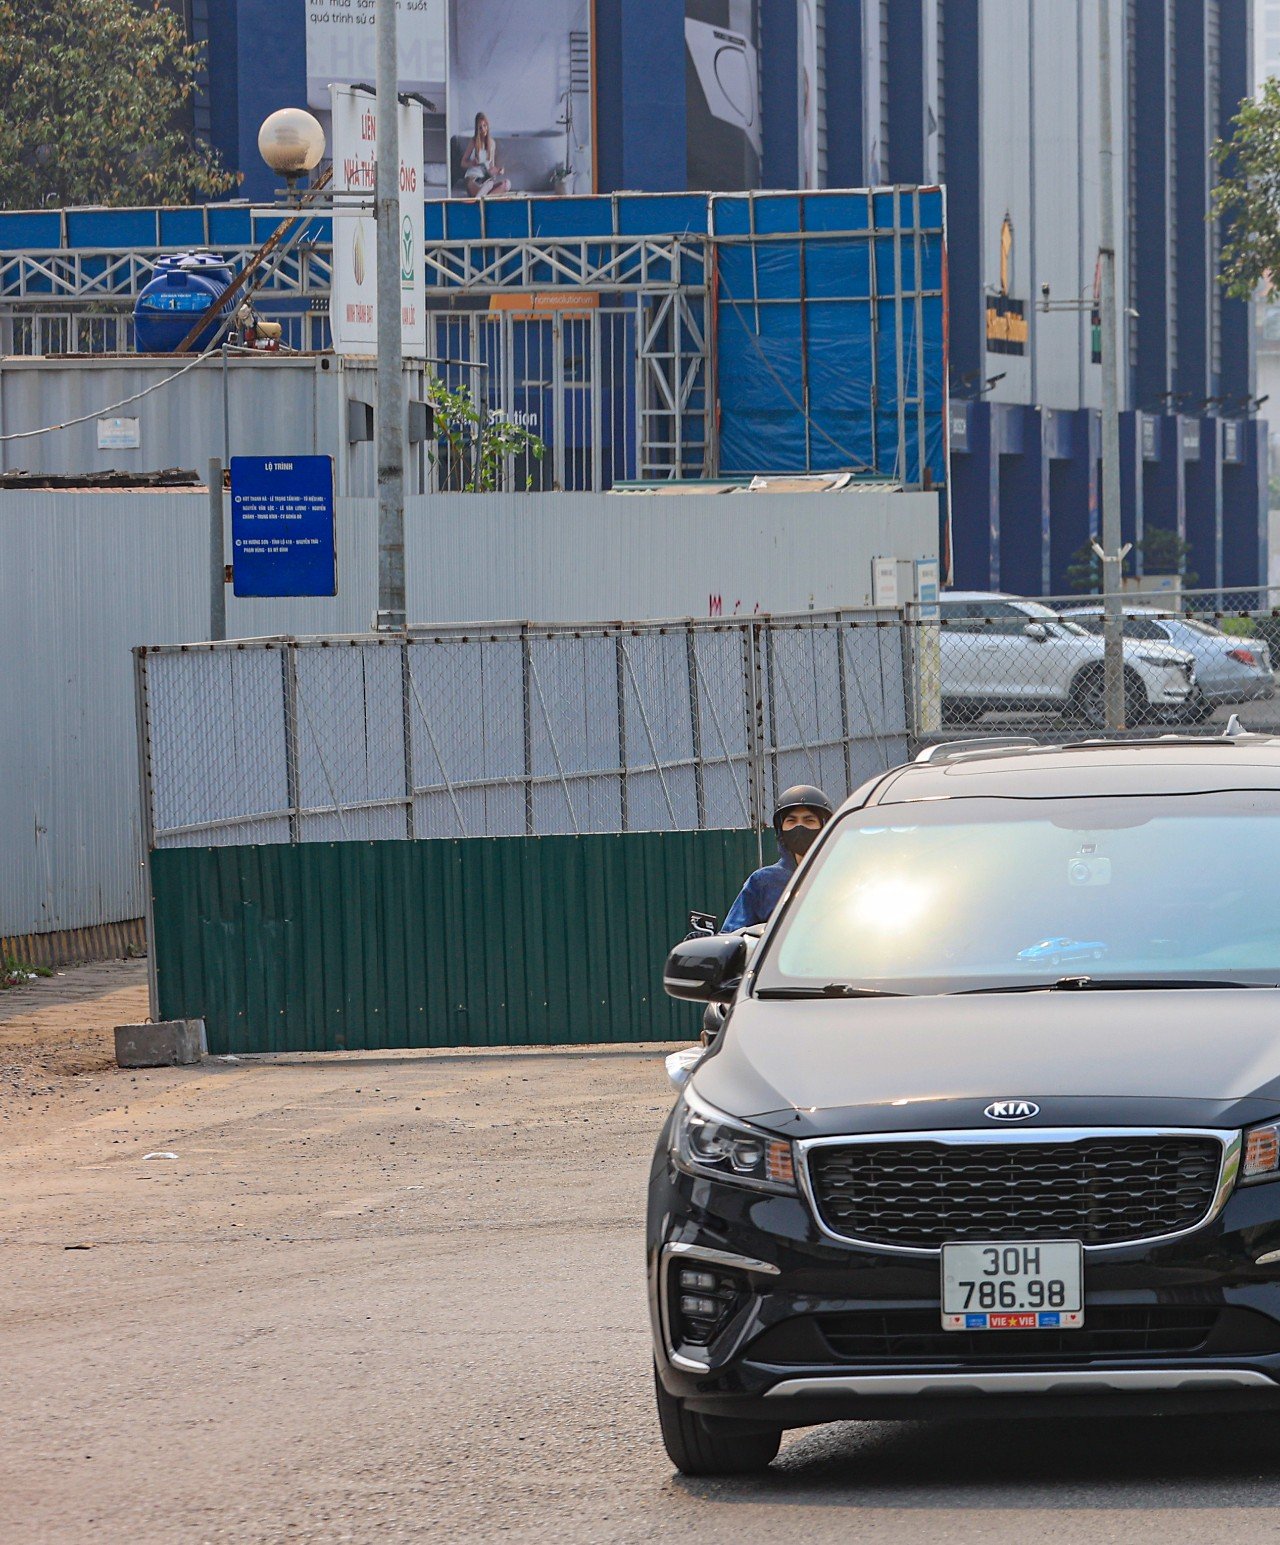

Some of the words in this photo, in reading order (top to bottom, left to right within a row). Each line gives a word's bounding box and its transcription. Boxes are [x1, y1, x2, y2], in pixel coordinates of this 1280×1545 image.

[332, 13, 354, 24] trình
[361, 108, 376, 141] LIÊN
[344, 152, 360, 187] NHÀ
[400, 160, 417, 193] ÔNG
[265, 462, 273, 472] LỘ
[274, 462, 293, 470] TRÌNH
[994, 1102, 1031, 1116] KIA
[983, 1248, 1041, 1276] 30H
[959, 1280, 1065, 1309] 786.98
[992, 1317, 1007, 1326] VIE
[1019, 1316, 1034, 1326] VIE
